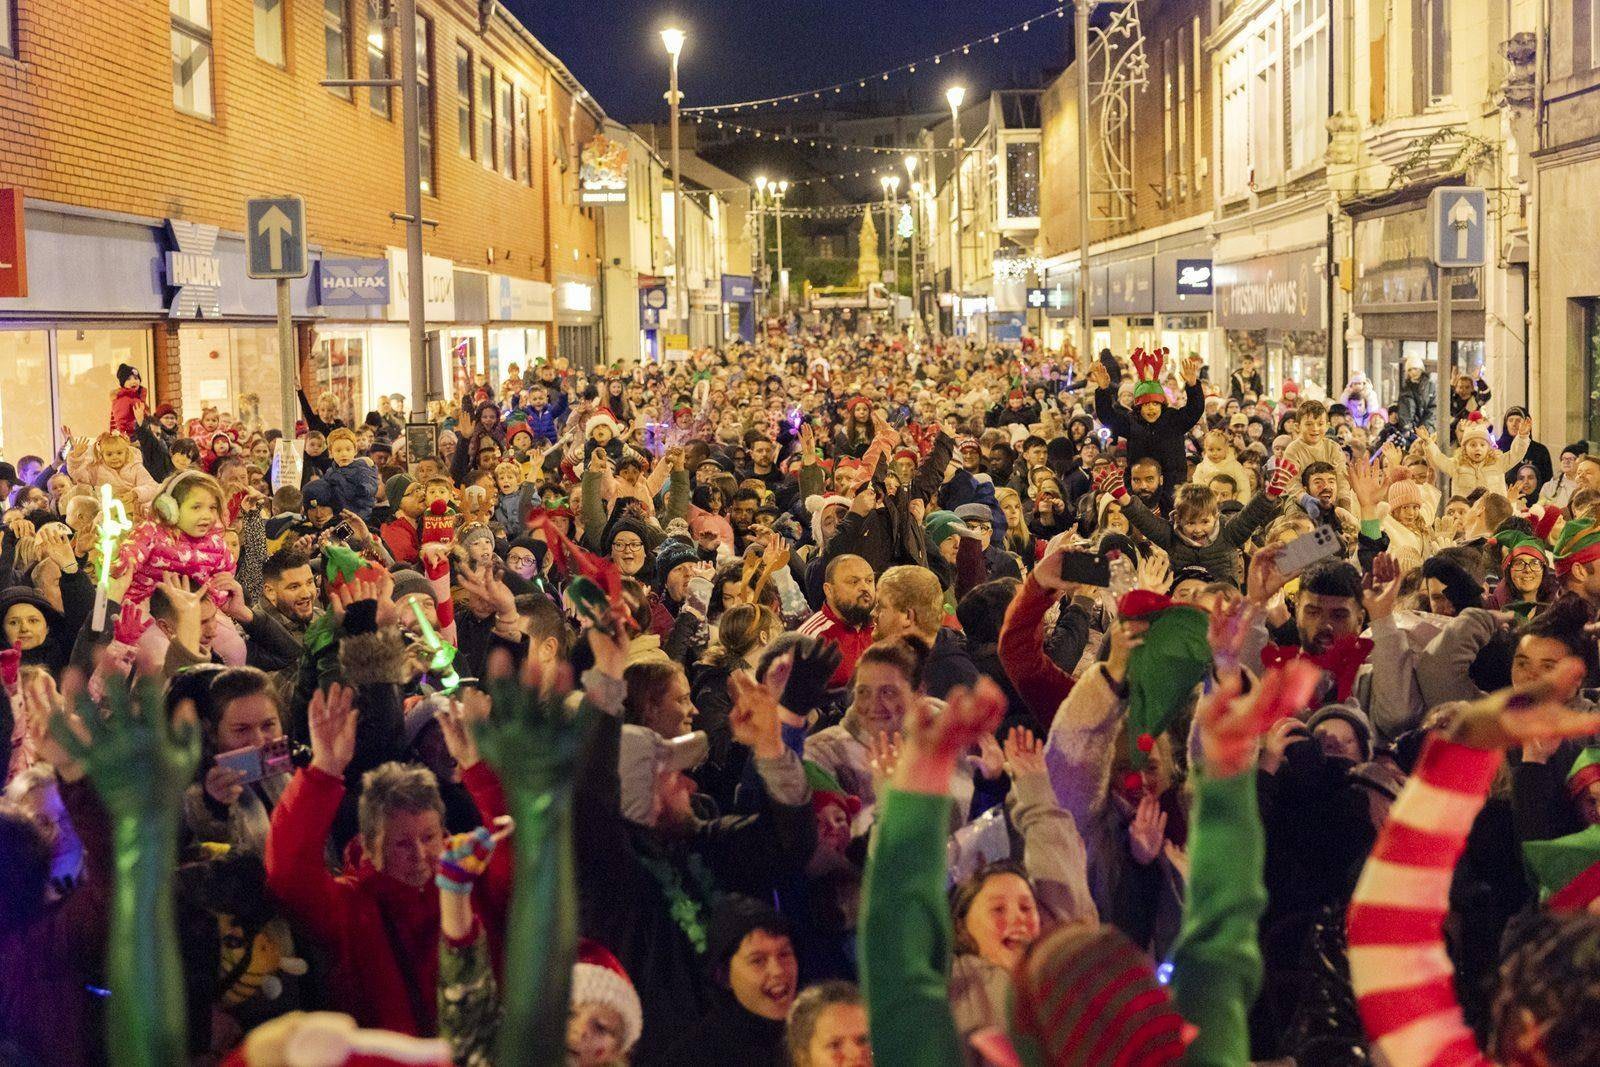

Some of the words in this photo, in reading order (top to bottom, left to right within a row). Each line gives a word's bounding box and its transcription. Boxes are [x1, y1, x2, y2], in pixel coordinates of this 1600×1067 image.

[173, 253, 221, 287] HALIFAX
[322, 276, 386, 288] HALIFAX
[425, 521, 454, 529] CYMR
